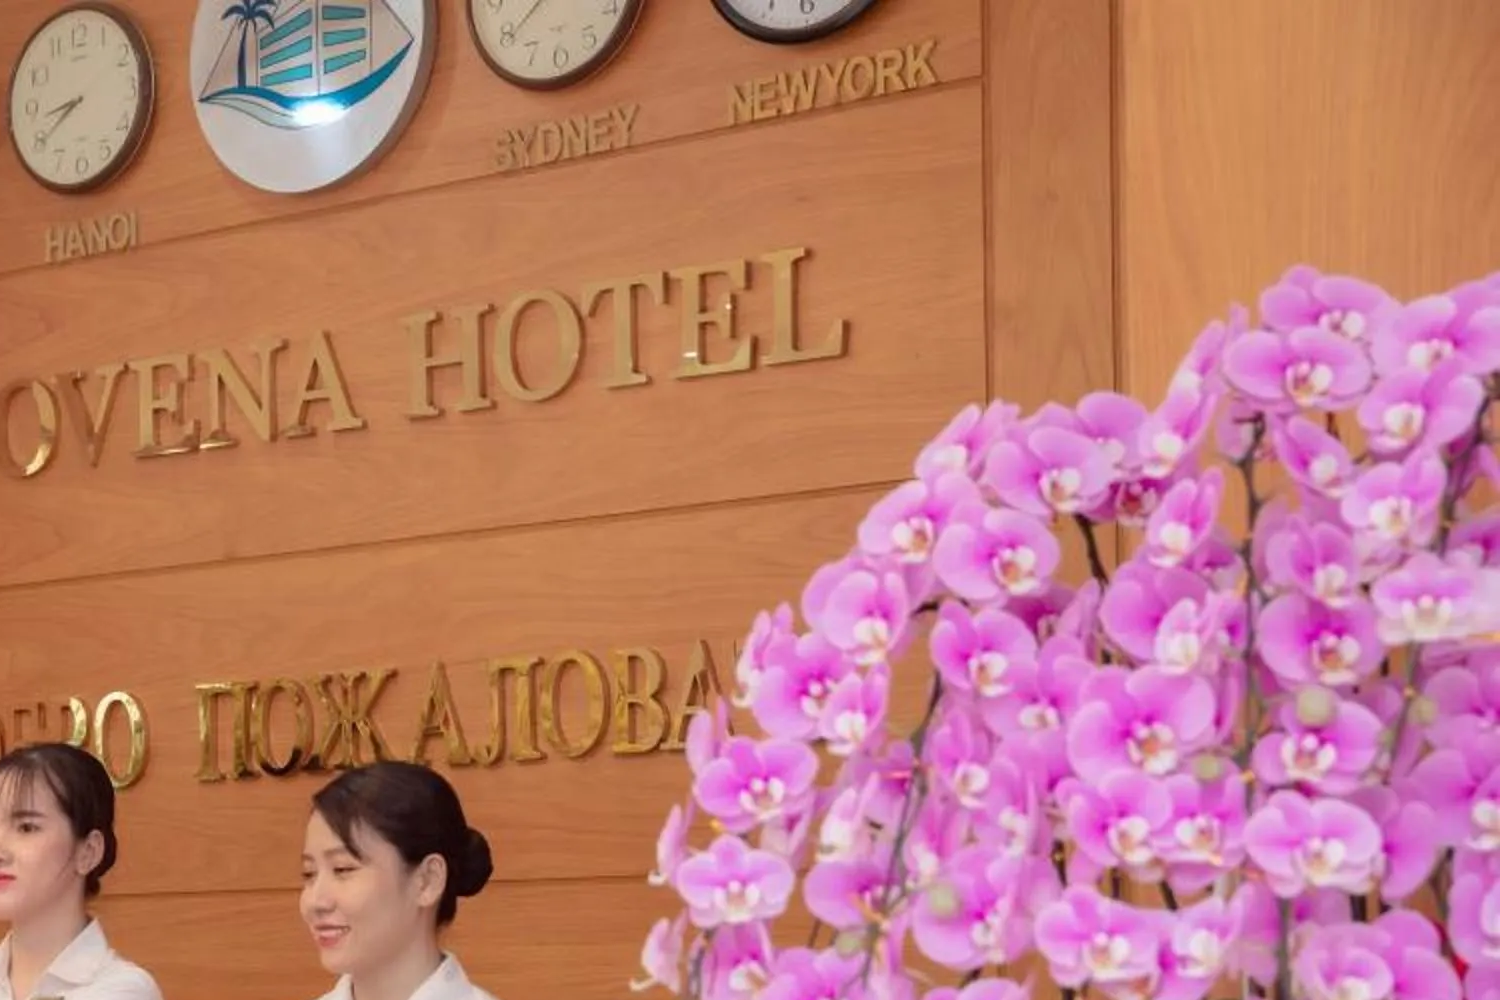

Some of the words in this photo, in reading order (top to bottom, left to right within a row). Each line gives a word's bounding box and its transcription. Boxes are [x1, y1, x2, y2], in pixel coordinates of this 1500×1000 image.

[71, 23, 87, 49] 12
[499, 22, 515, 48] 8
[524, 40, 539, 66] 7
[729, 40, 939, 124] NEWYORK
[496, 104, 640, 169] SYDNEY
[45, 212, 138, 262] HANOI
[404, 247, 850, 421] HOTEL
[194, 638, 740, 782] ПОЖАЛОВА
